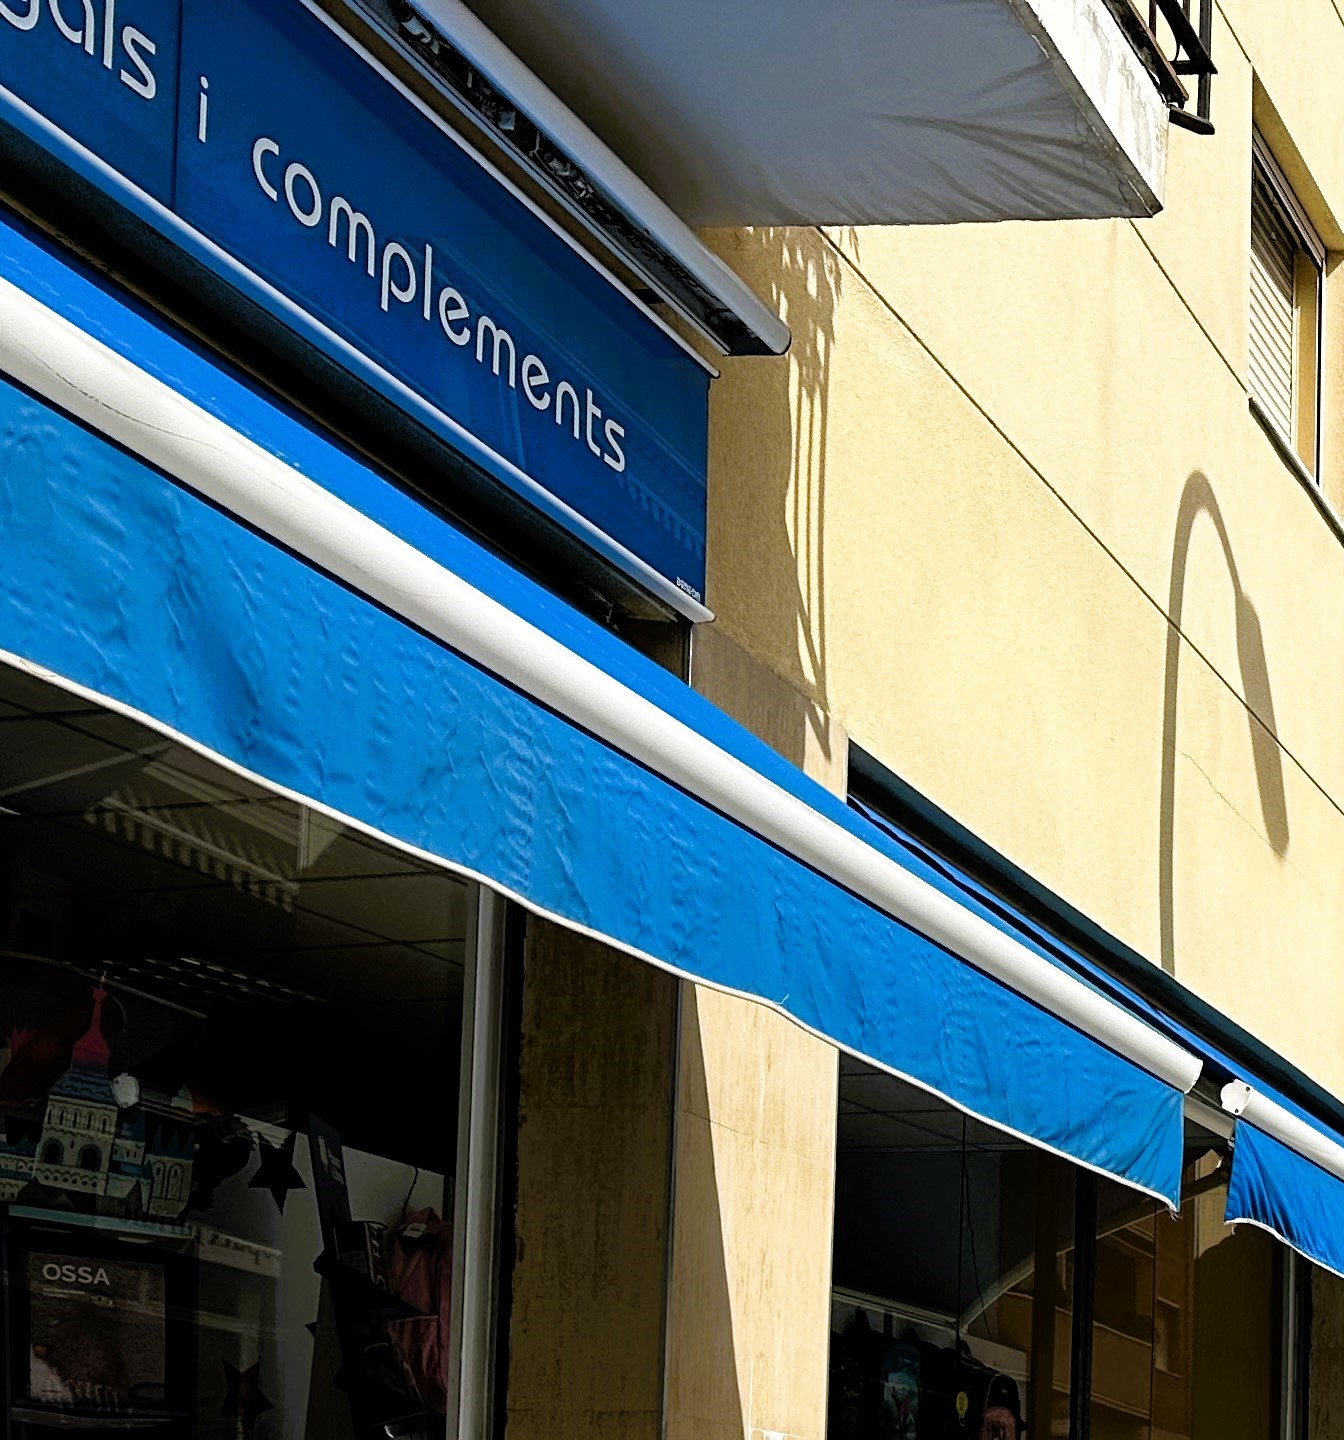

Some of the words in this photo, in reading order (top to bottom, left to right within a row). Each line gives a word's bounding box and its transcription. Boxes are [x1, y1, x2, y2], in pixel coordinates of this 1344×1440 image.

[199, 76, 208, 143] i
[253, 137, 625, 473] complements
[42, 1263, 111, 1287] OSSA
